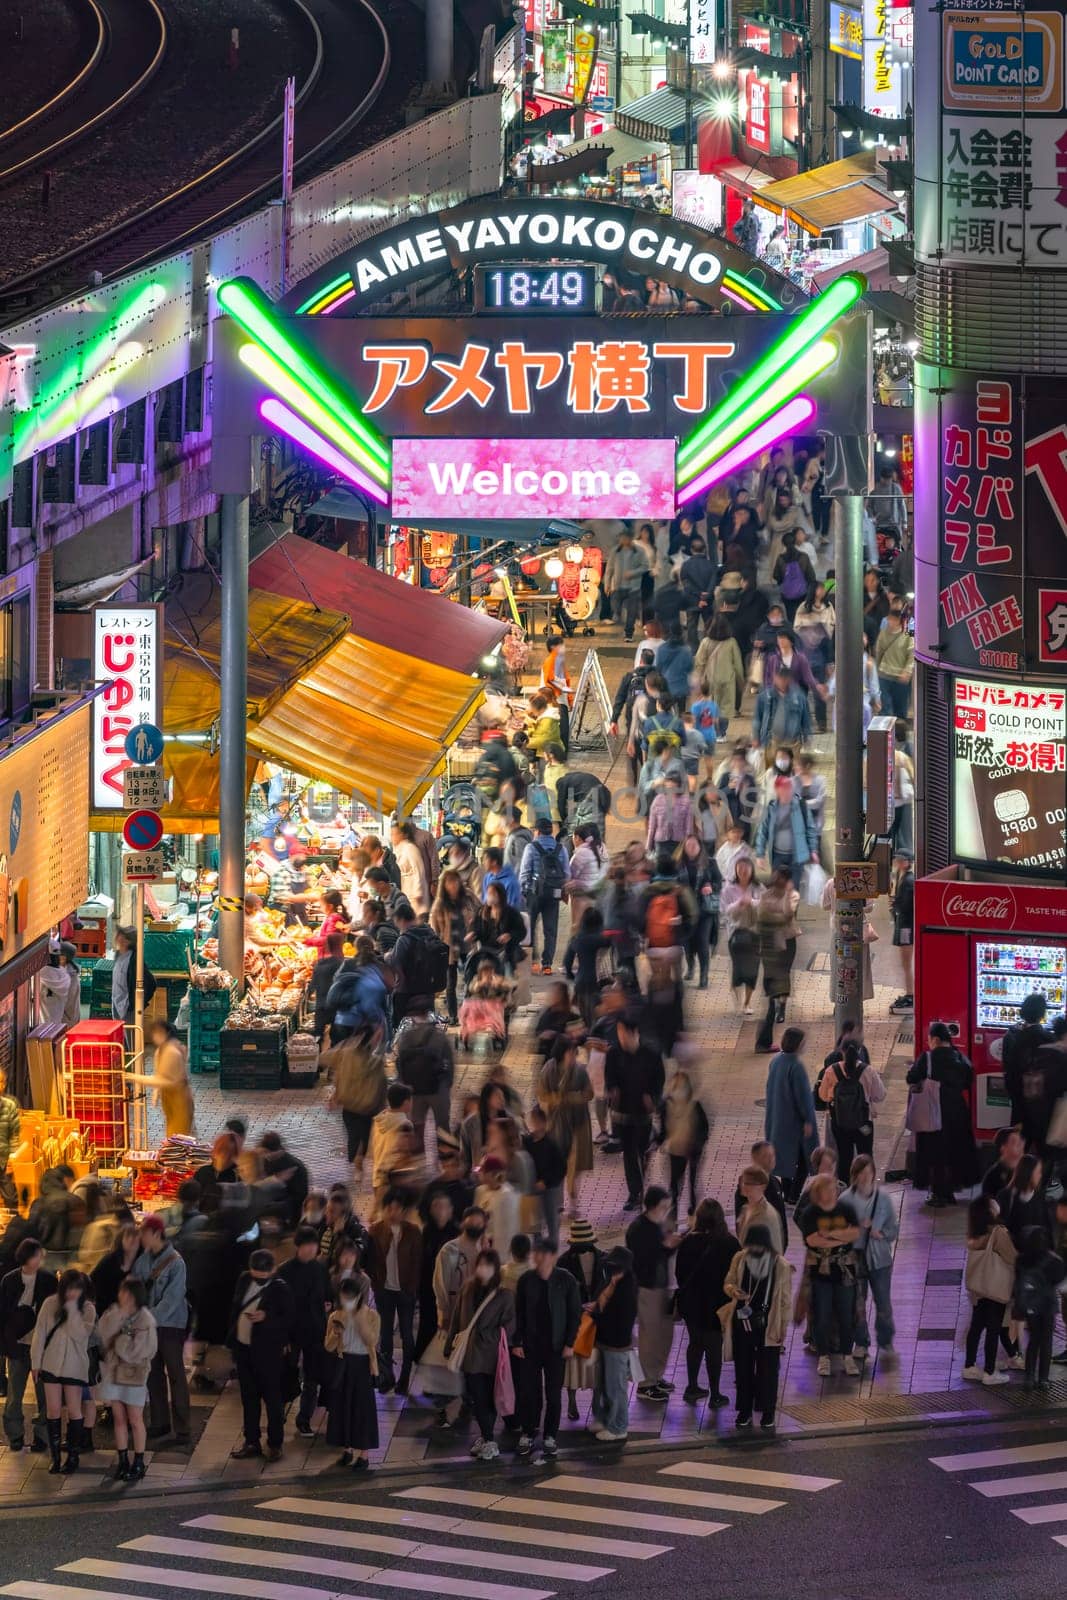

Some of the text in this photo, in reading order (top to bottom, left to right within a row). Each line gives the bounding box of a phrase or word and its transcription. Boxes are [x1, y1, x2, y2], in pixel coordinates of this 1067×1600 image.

[968, 34, 1022, 60] GOLD
[956, 62, 1040, 83] POINT CARD
[947, 128, 1033, 168] 入会金
[947, 169, 1033, 211] 年会費
[354, 213, 724, 294] AMEYAYOKOCHO
[946, 216, 1062, 256] 店頭にて
[490, 271, 584, 307] 18:49
[361, 340, 737, 414] アメヤ横丁
[428, 462, 641, 498] Welcome
[975, 380, 1014, 566] ヨドバシ
[944, 424, 972, 563] カメラ
[939, 572, 986, 629] TAX
[99, 617, 153, 628] レストラン
[966, 594, 1022, 650] FREE
[139, 633, 152, 702] 東京名物
[979, 650, 1018, 668] STORE
[956, 683, 1065, 710] ヨドバシカメラ
[989, 713, 1065, 731] GOLD POINT
[988, 767, 1012, 780] GOLD
[1001, 817, 1038, 836] 4980
[946, 895, 1011, 919] Coca-Cola
[1025, 907, 1050, 915] TASTE
